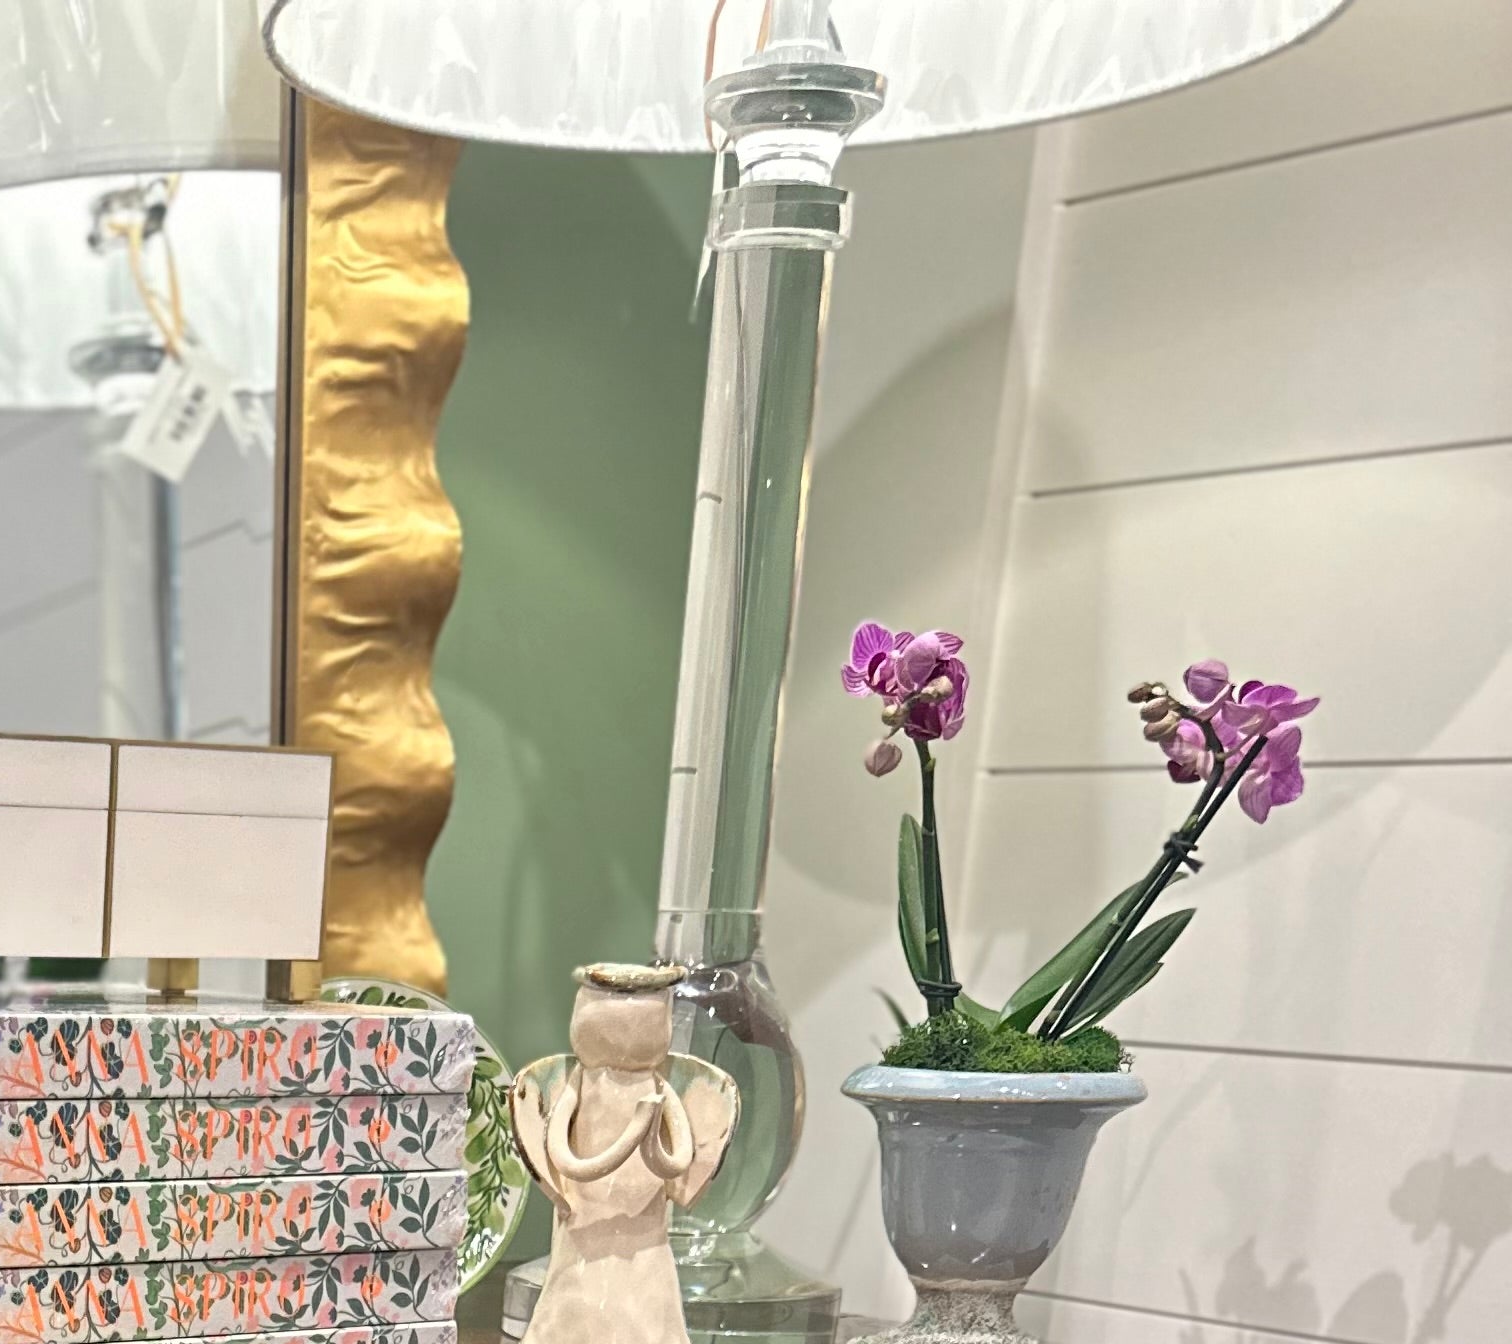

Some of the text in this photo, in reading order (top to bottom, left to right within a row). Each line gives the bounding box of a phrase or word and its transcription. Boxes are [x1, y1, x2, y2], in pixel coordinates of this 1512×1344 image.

[14, 1028, 318, 1085] ANNA SPIRO
[14, 1107, 311, 1167] ANNA SPIRO
[16, 1191, 312, 1255] ANNA SPIRO
[16, 1270, 306, 1332] ANNA SPIRO
